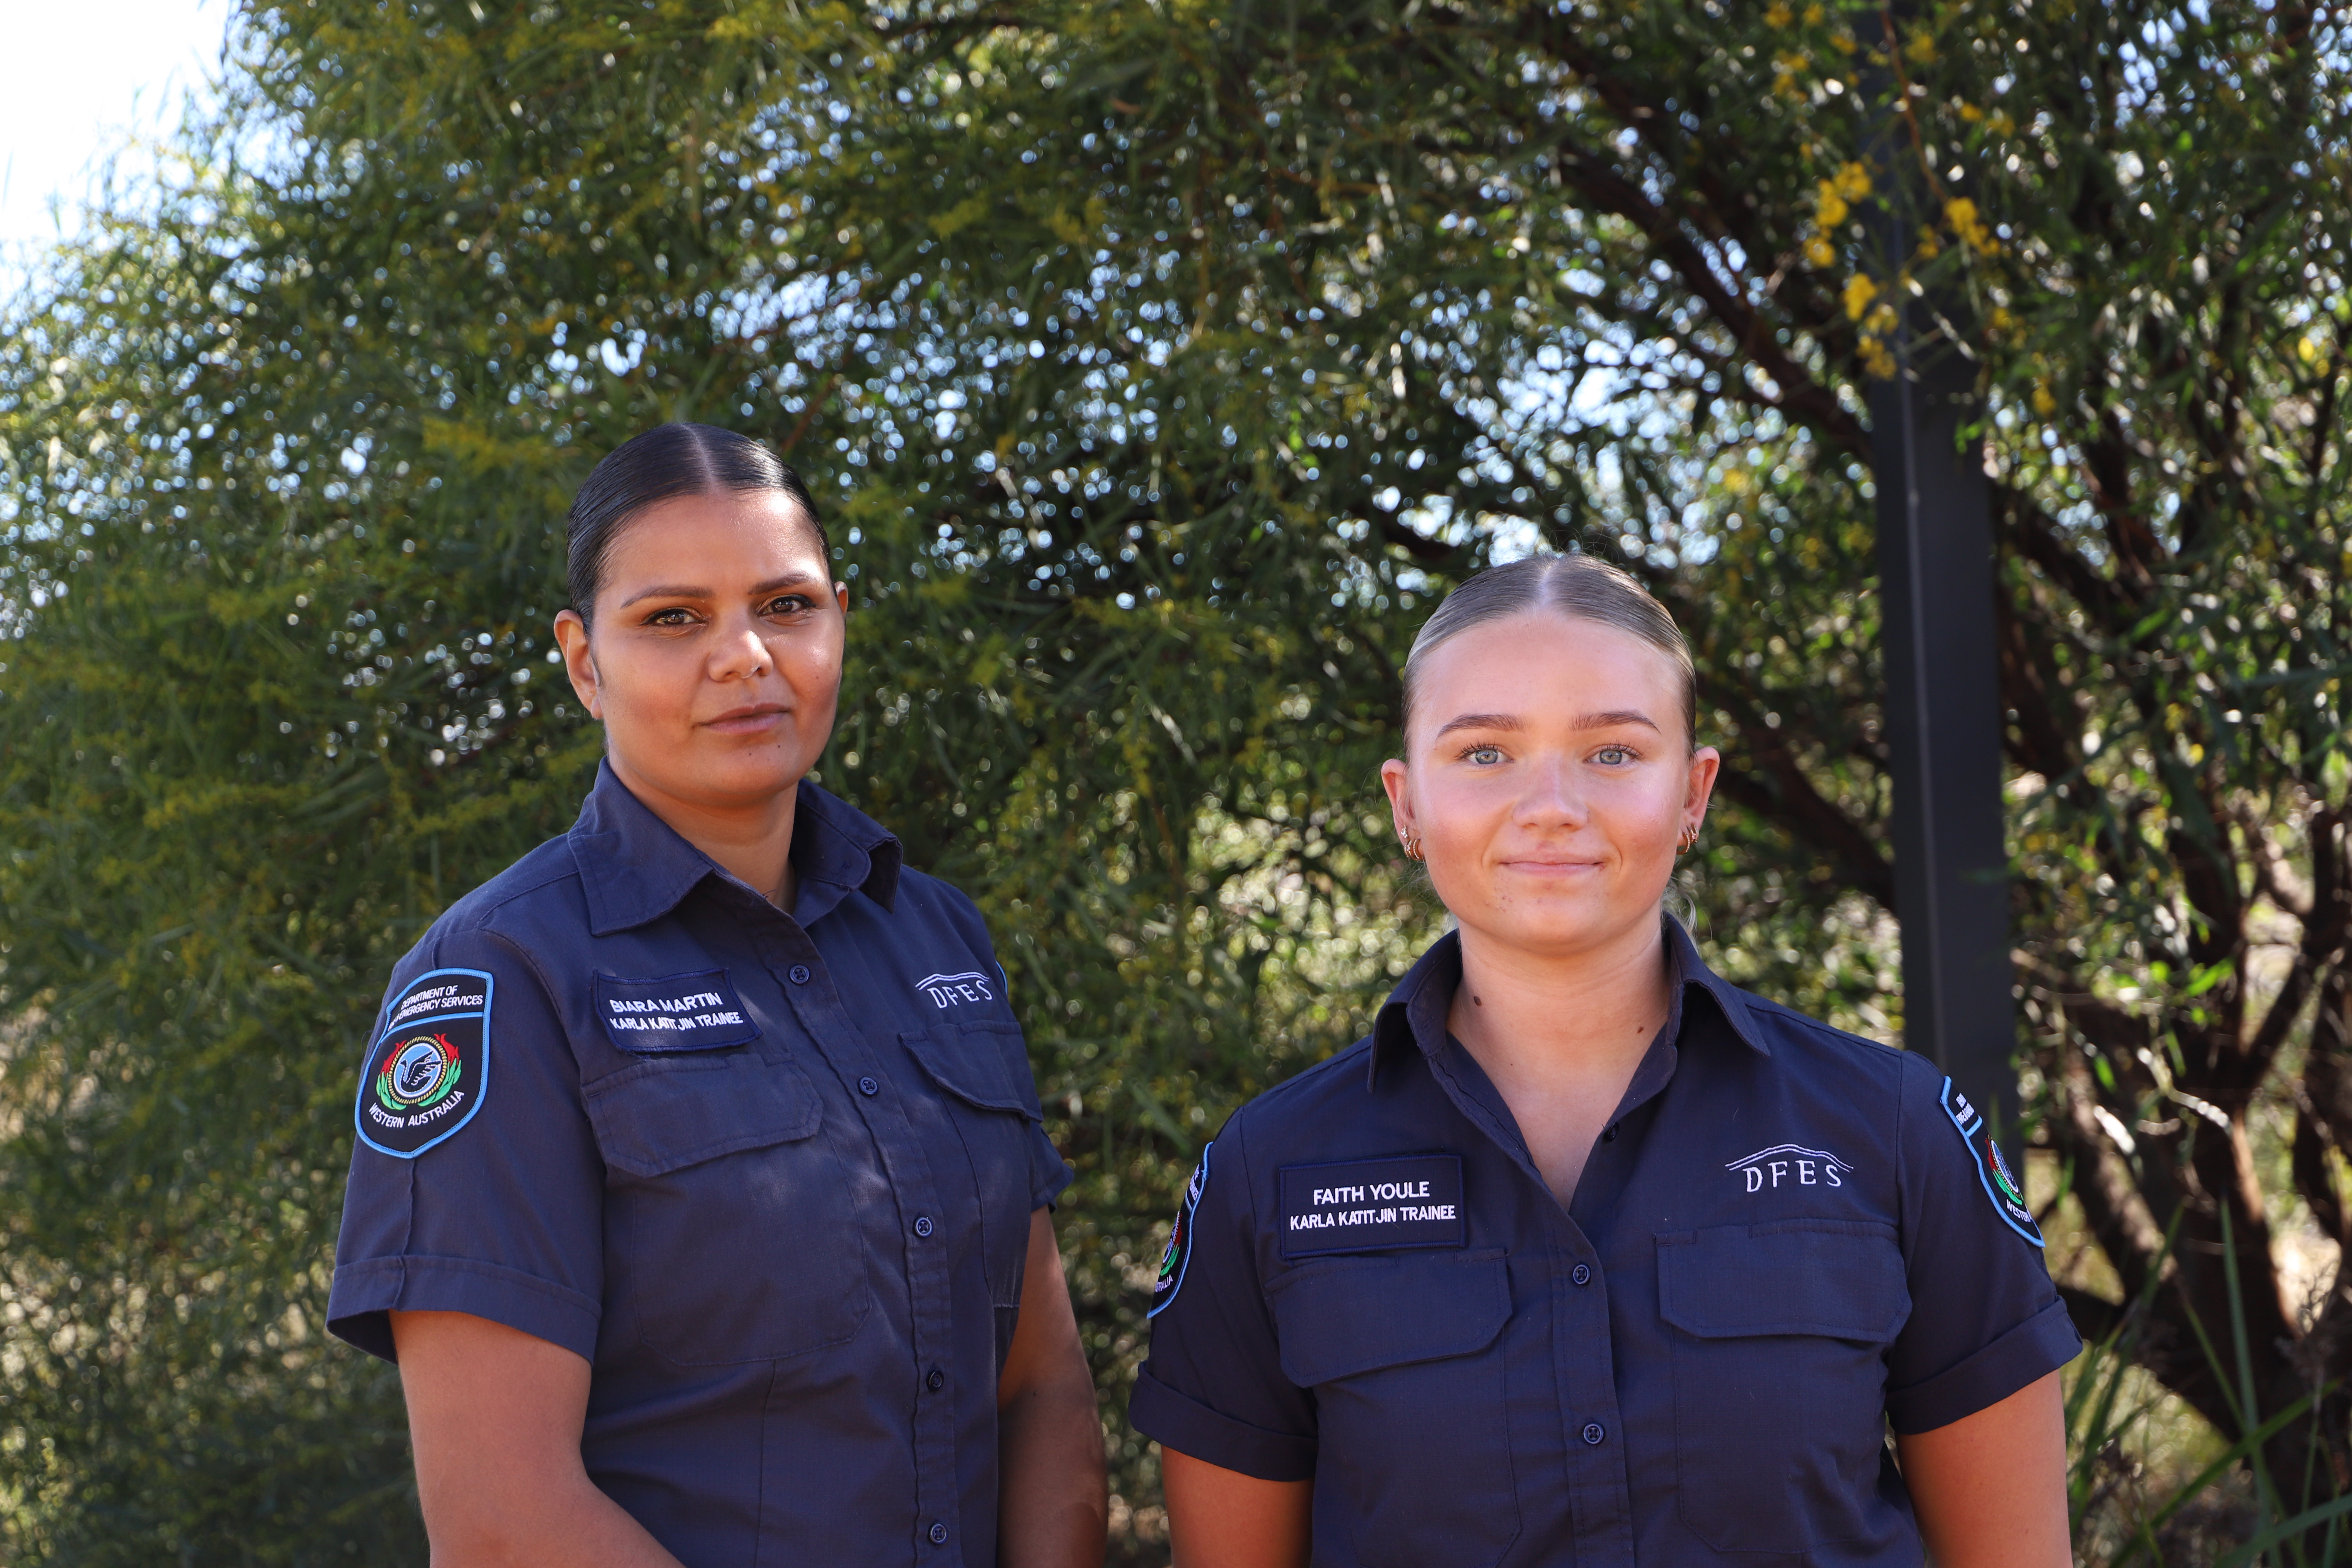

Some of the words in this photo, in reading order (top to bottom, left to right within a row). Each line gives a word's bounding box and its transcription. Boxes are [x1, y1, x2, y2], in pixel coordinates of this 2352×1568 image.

[401, 987, 445, 1010] DEPARTMENT
[446, 985, 458, 996] OF
[609, 999, 660, 1013] BIARA
[658, 992, 723, 1012] MARTIN
[927, 980, 992, 1008] DFES
[399, 998, 441, 1020] EMERGENCY
[441, 995, 483, 1008] SERVICES
[609, 1018, 649, 1030] KARLA
[695, 1012, 744, 1026] TRAINEE
[369, 1102, 404, 1128] WESTERN
[408, 1090, 464, 1126] AUSTRALIA
[1742, 1160, 1841, 1192] DFES
[1314, 1185, 1364, 1205] FAITH
[1370, 1181, 1430, 1200] YOULE
[1290, 1213, 1335, 1230] KARLA
[1400, 1205, 1456, 1221] TRAINEE
